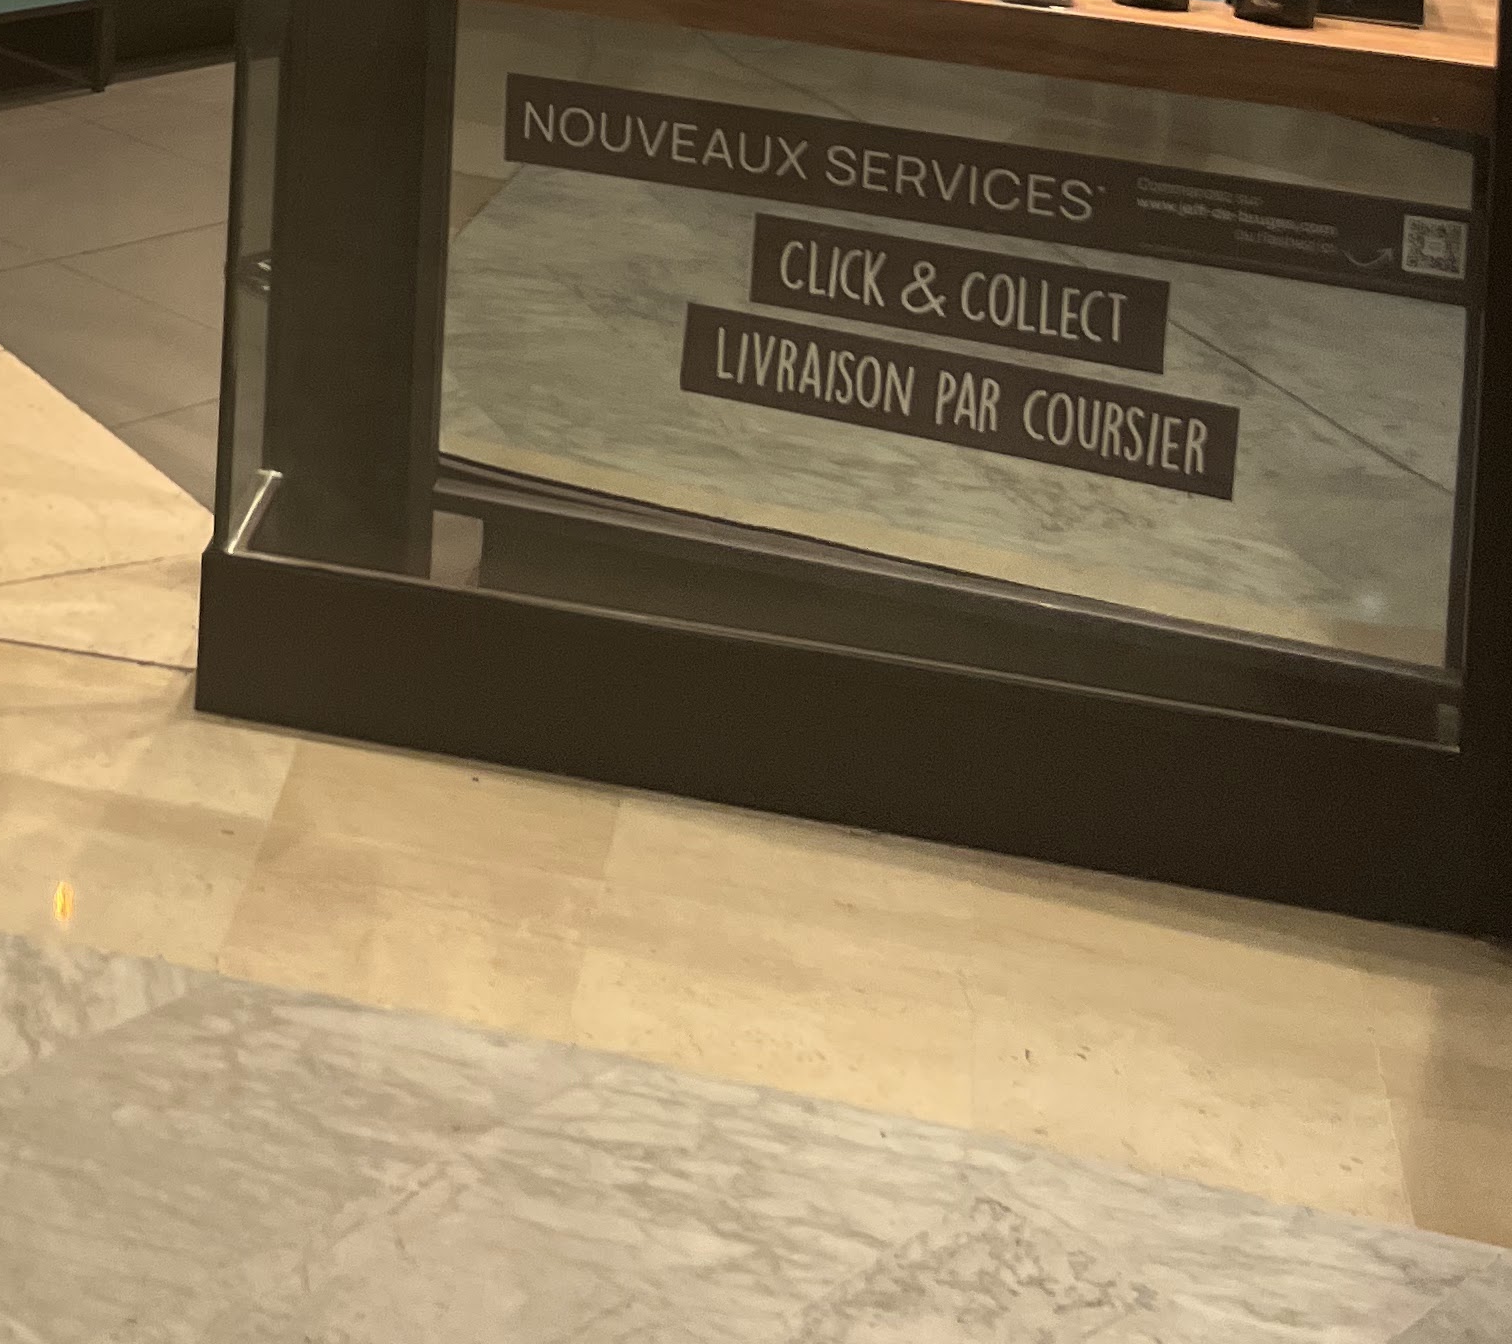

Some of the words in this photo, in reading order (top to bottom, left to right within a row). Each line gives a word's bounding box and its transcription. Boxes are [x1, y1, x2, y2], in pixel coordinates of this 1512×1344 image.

[522, 100, 810, 180] NOUVEAUX
[780, 240, 886, 307] CLICK
[901, 260, 947, 318] &
[961, 271, 1128, 343] COLLECT
[716, 326, 915, 417] LIVRAISON
[936, 370, 1001, 432] PAR
[1023, 388, 1208, 475] COURSIER
